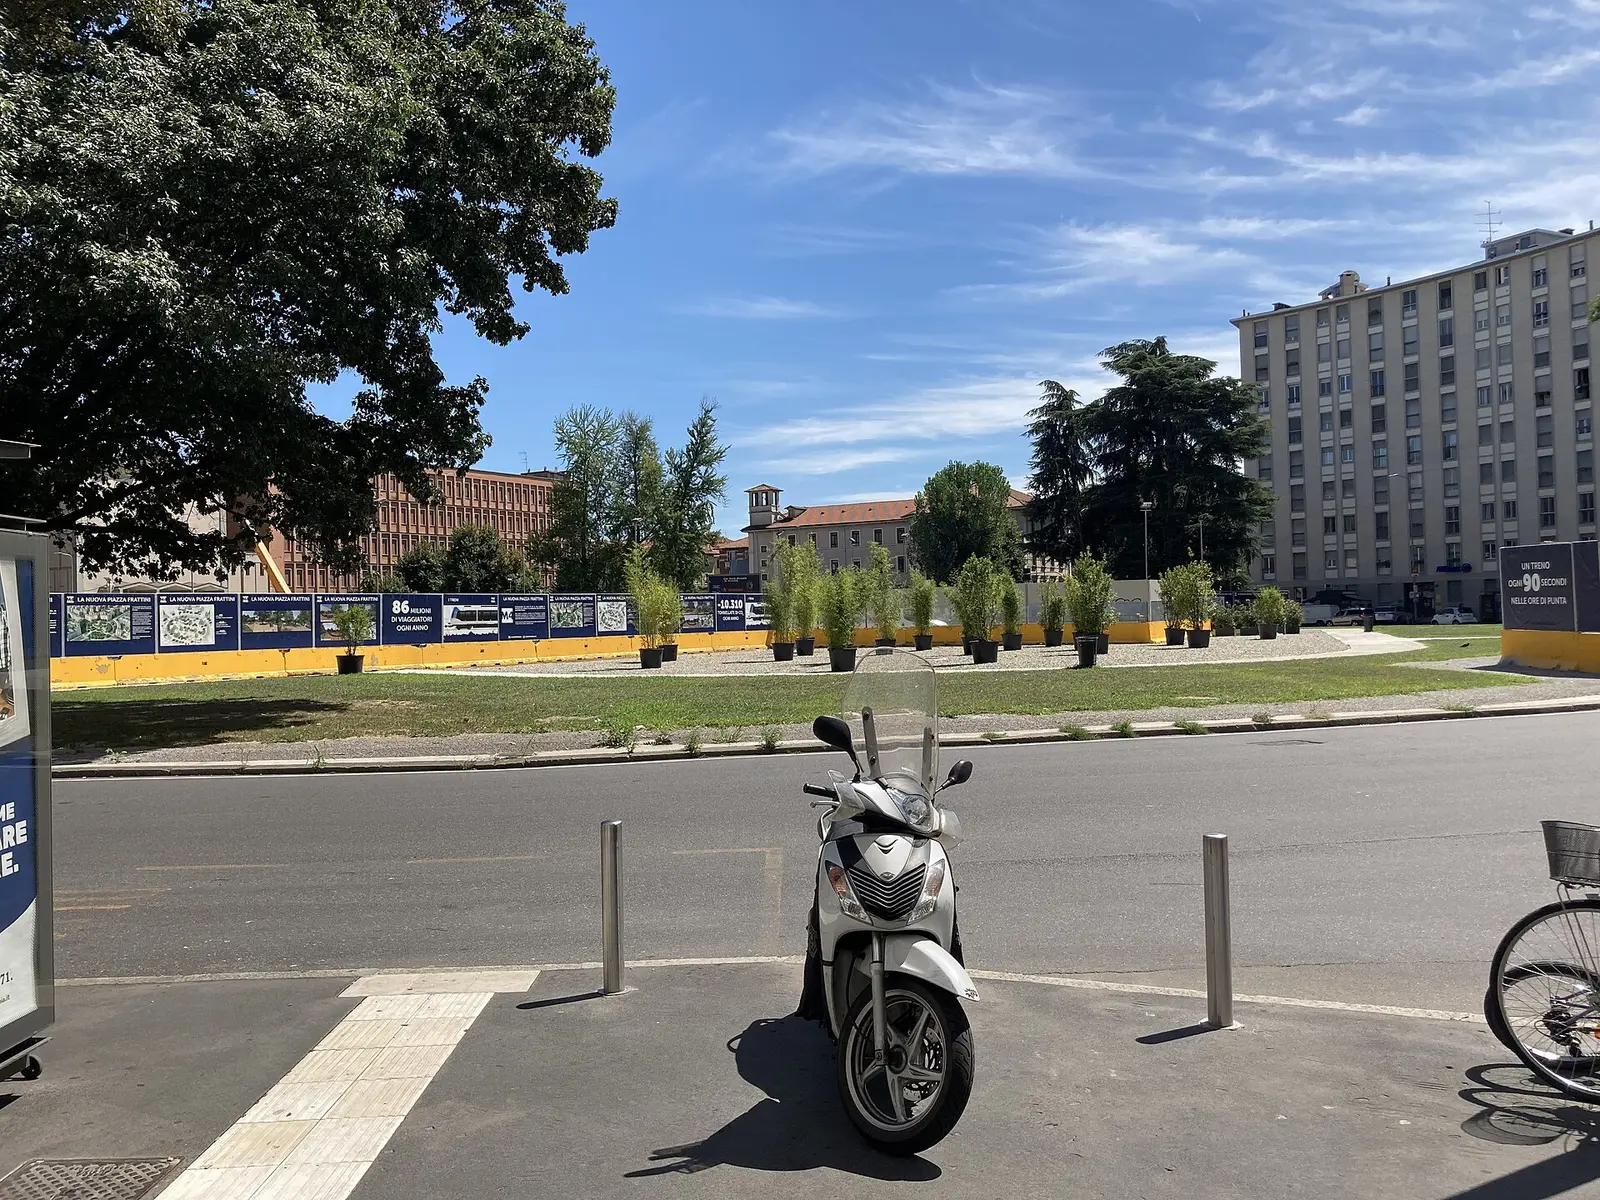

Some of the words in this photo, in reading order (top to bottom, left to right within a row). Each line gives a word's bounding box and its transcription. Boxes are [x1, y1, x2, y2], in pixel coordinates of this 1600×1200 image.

[1521, 562, 1530, 570] UN
[1531, 562, 1550, 570] TRENO
[1508, 579, 1522, 588] OGNI
[1523, 573, 1540, 592] 90
[1541, 578, 1567, 586] SECONDI
[717, 599, 743, 609] -10.310
[1510, 597, 1528, 605] NELLE
[1527, 597, 1540, 605] ORE
[1540, 597, 1547, 605] DI
[1547, 597, 1567, 605] PUNTA
[392, 600, 410, 614] 86
[396, 624, 411, 632] OGNI
[0, 820, 28, 851] RE
